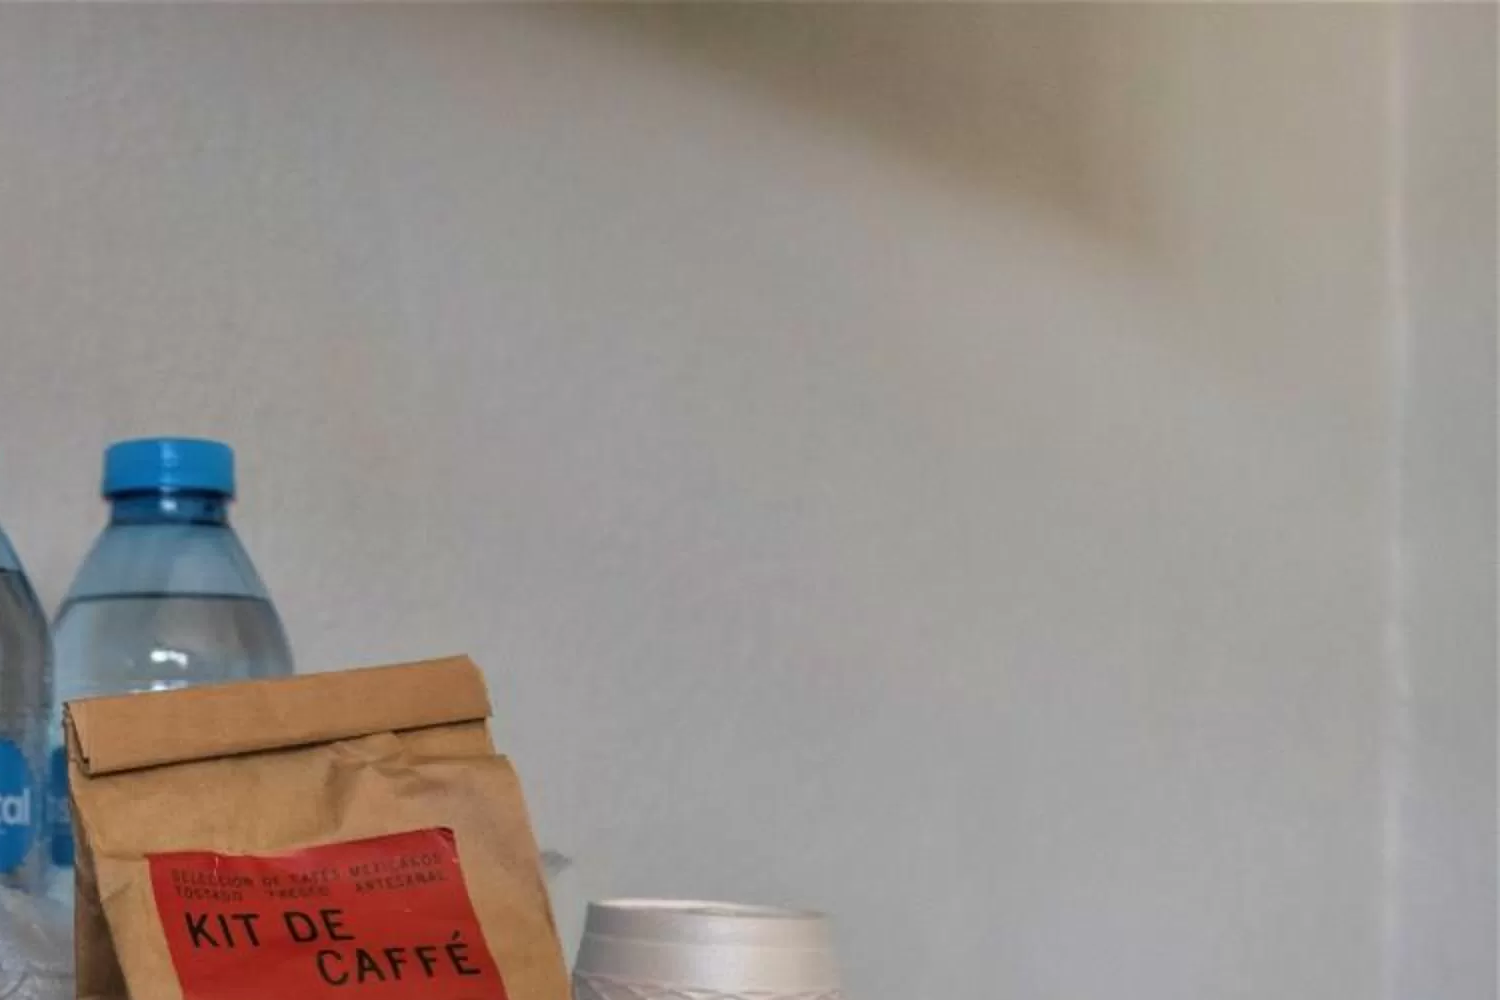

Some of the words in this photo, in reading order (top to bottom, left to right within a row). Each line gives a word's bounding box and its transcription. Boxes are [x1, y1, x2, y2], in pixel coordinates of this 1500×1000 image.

[184, 910, 260, 948] KIT
[283, 908, 355, 943] DE
[316, 930, 481, 986] CAFFÉ
